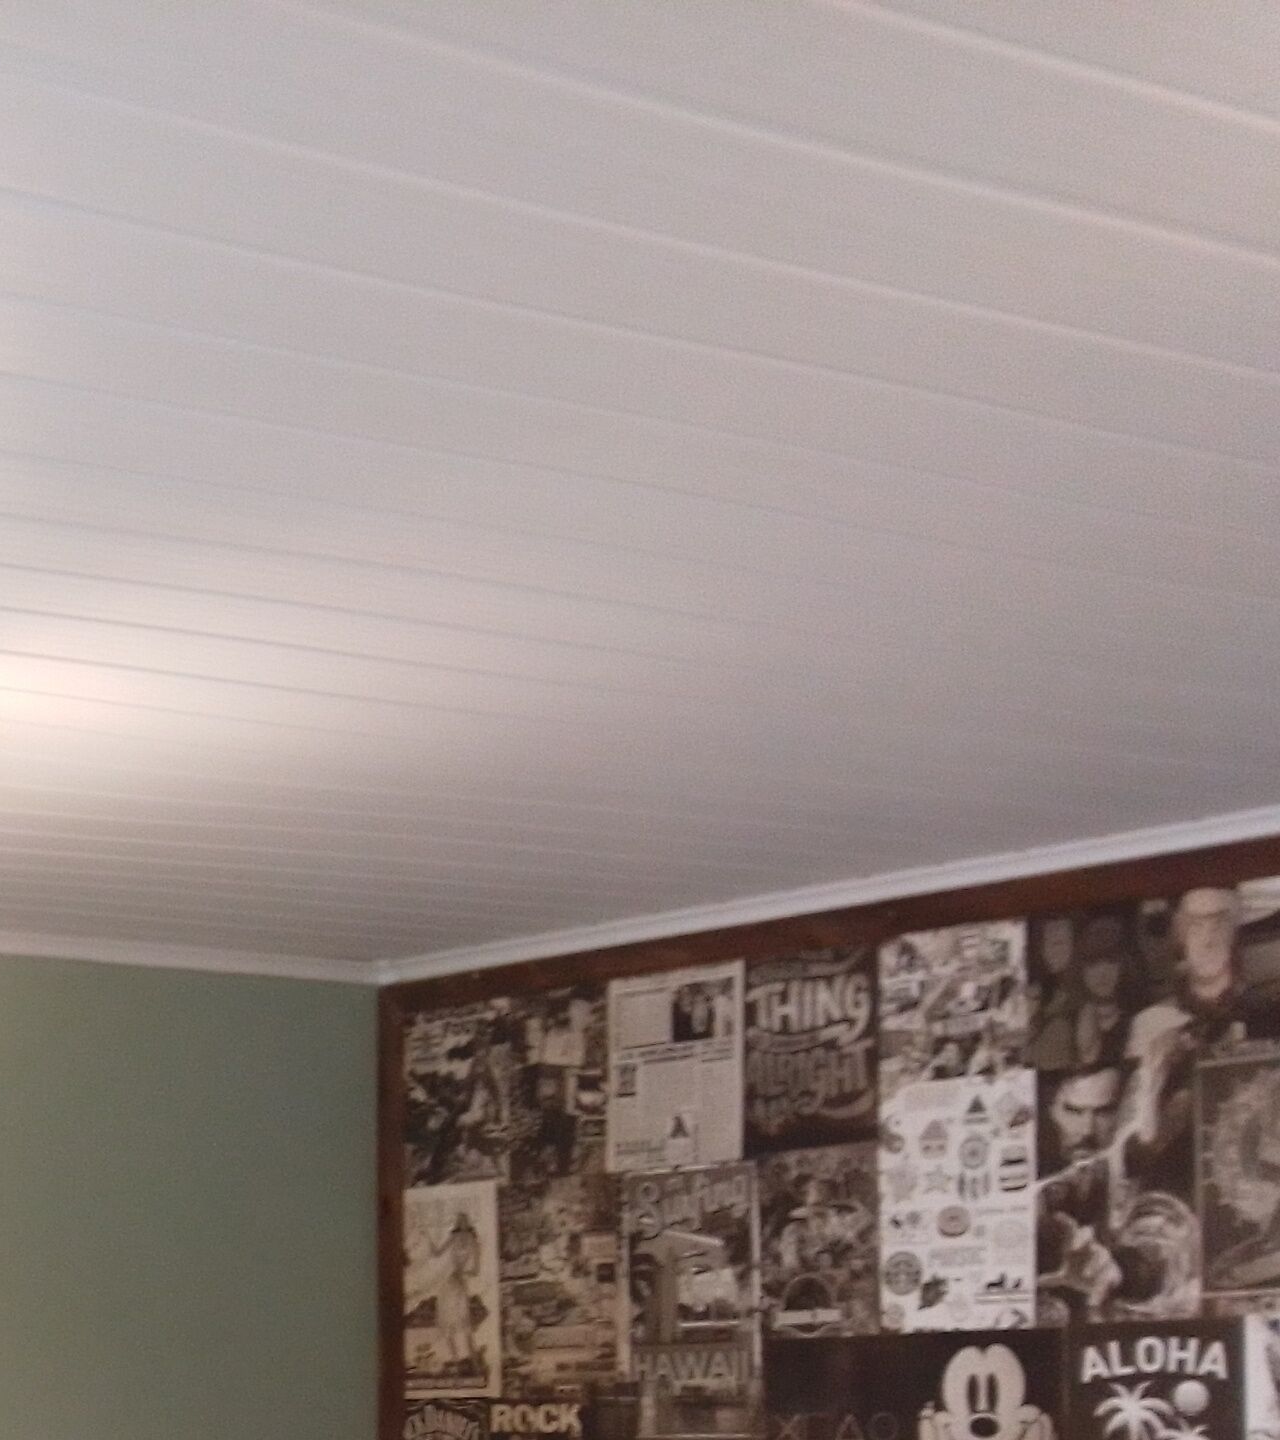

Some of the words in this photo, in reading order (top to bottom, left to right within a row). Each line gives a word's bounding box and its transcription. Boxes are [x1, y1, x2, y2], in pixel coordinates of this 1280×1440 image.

[742, 974, 872, 1048] THING
[1080, 1335, 1230, 1384] ALOHA
[490, 1402, 583, 1438] ROCK
